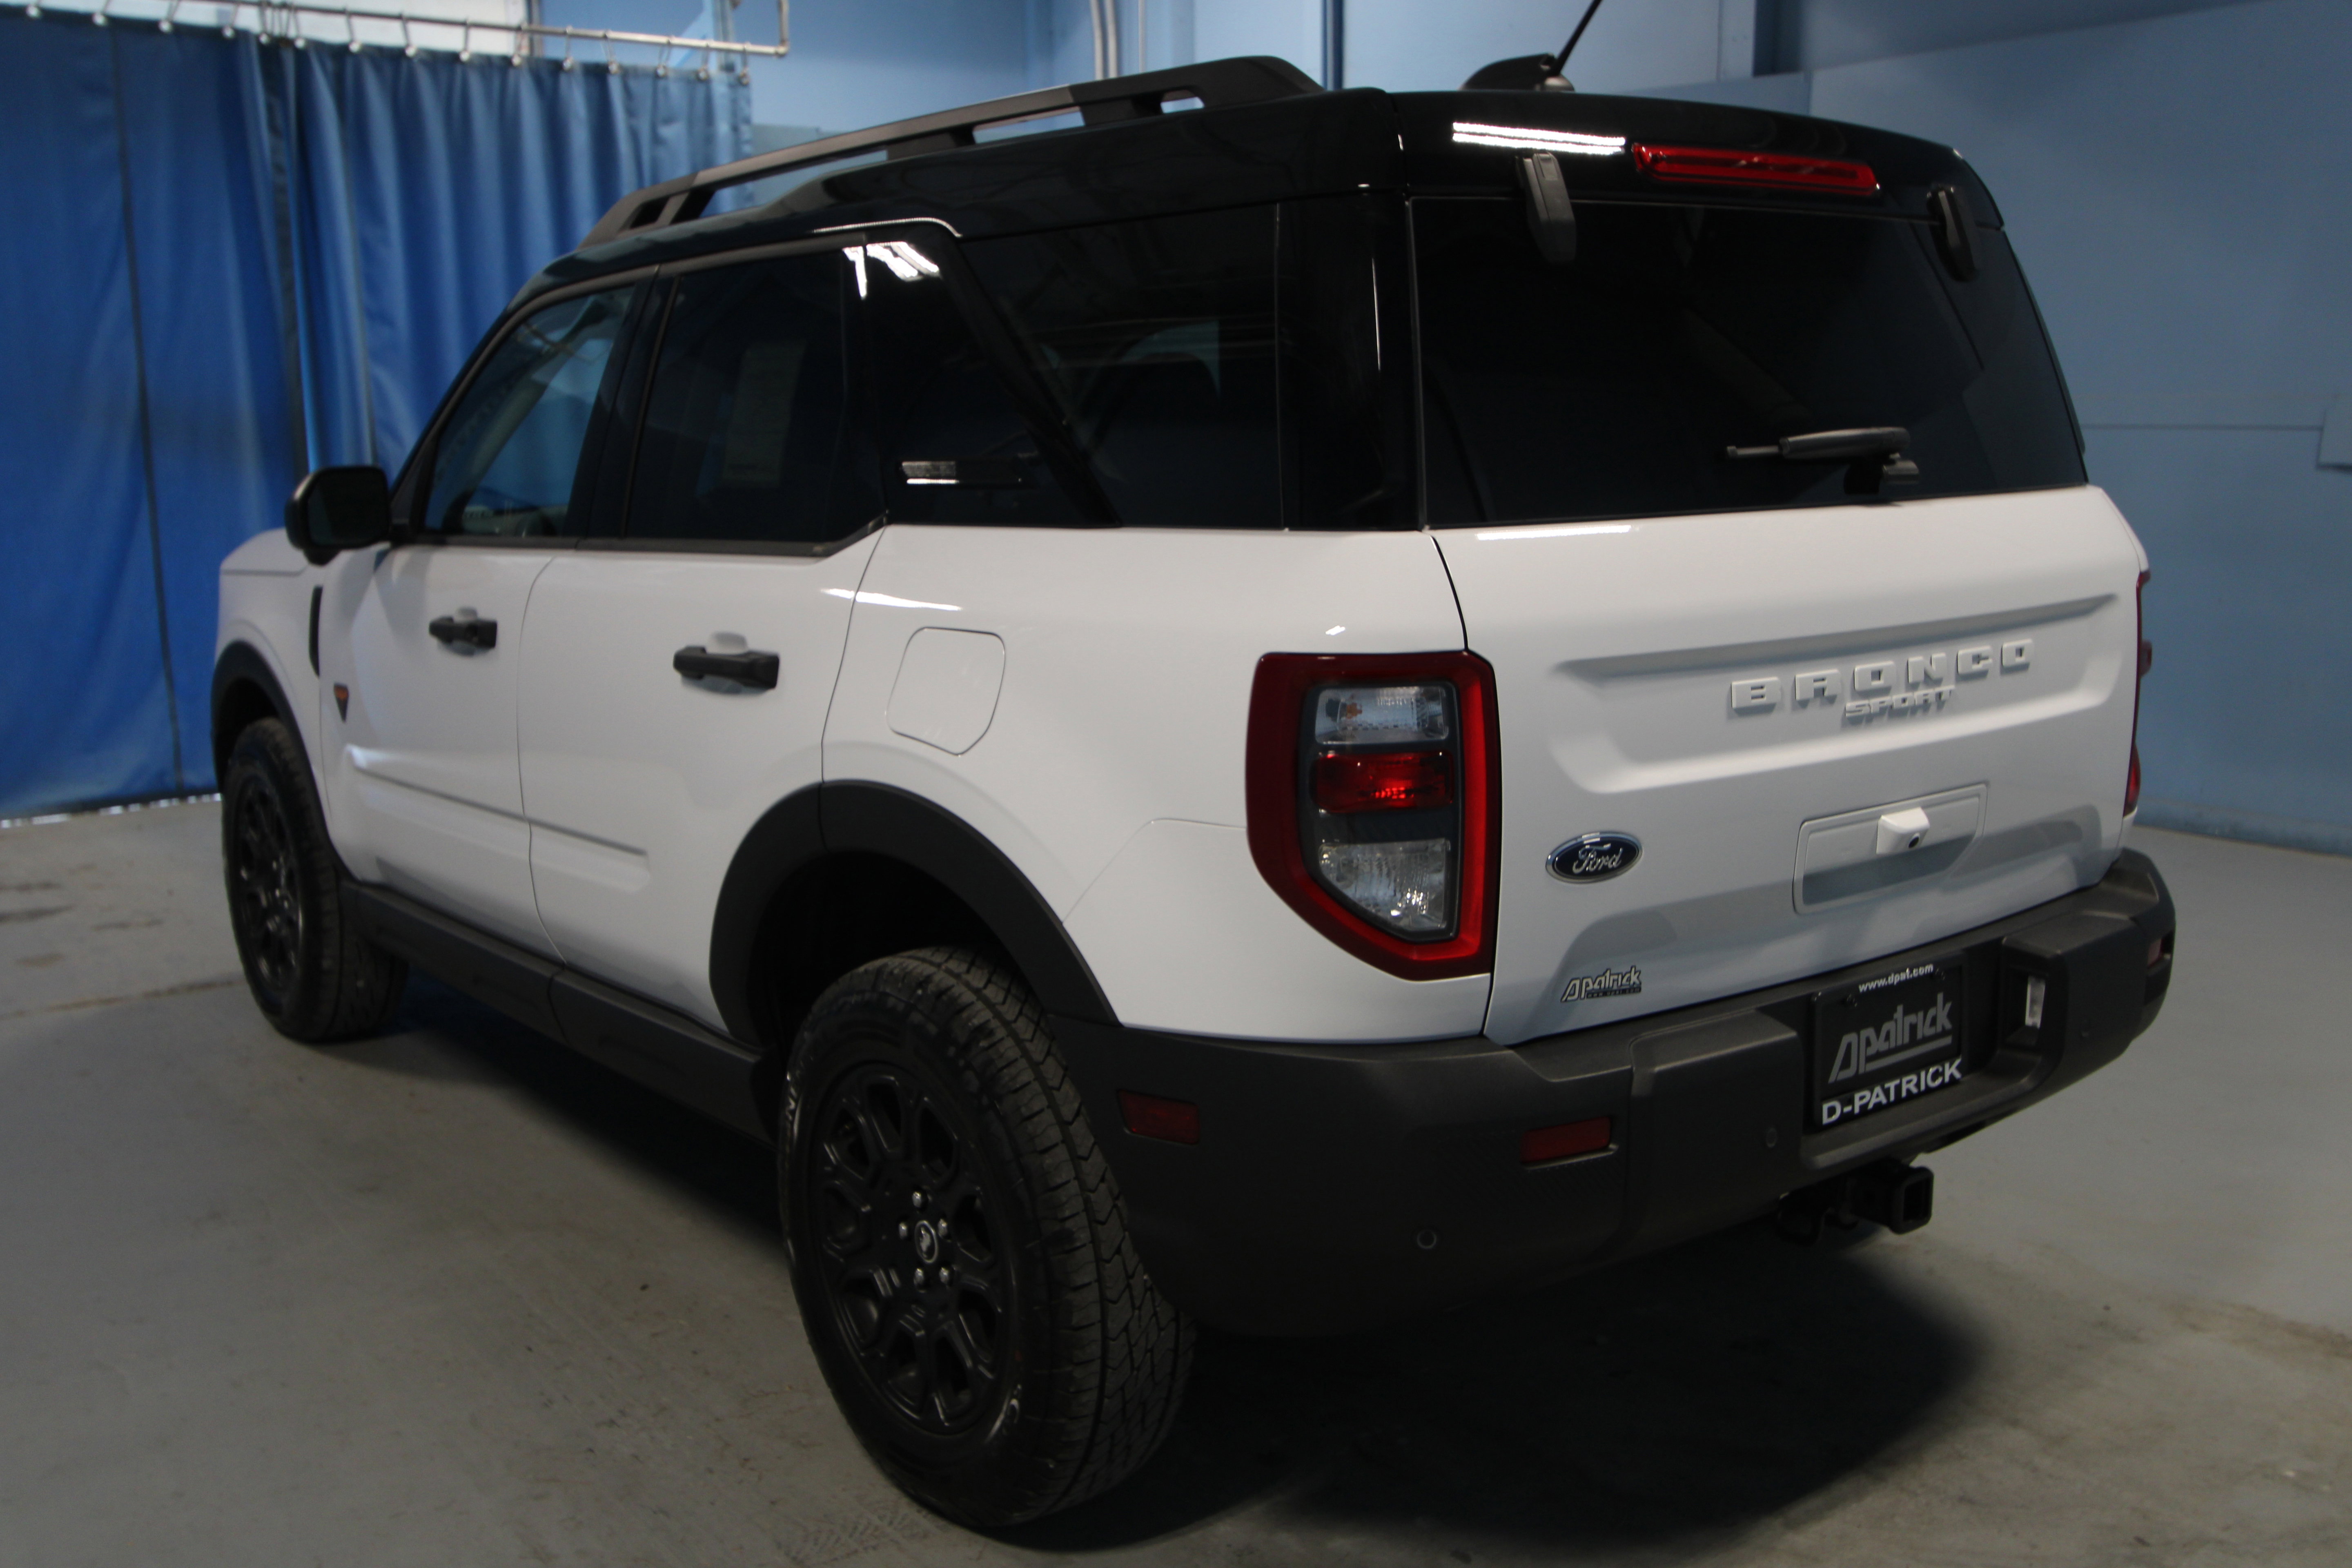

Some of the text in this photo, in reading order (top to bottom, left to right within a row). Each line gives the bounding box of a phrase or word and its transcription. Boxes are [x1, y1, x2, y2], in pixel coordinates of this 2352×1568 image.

[1731, 639, 2034, 709] BRONCO
[1845, 685, 1956, 717] SPORT
[1572, 843, 1624, 874] Ford
[1858, 964, 1933, 993] www.dpat.com
[1822, 1058, 1962, 1125] D-PATRICK
